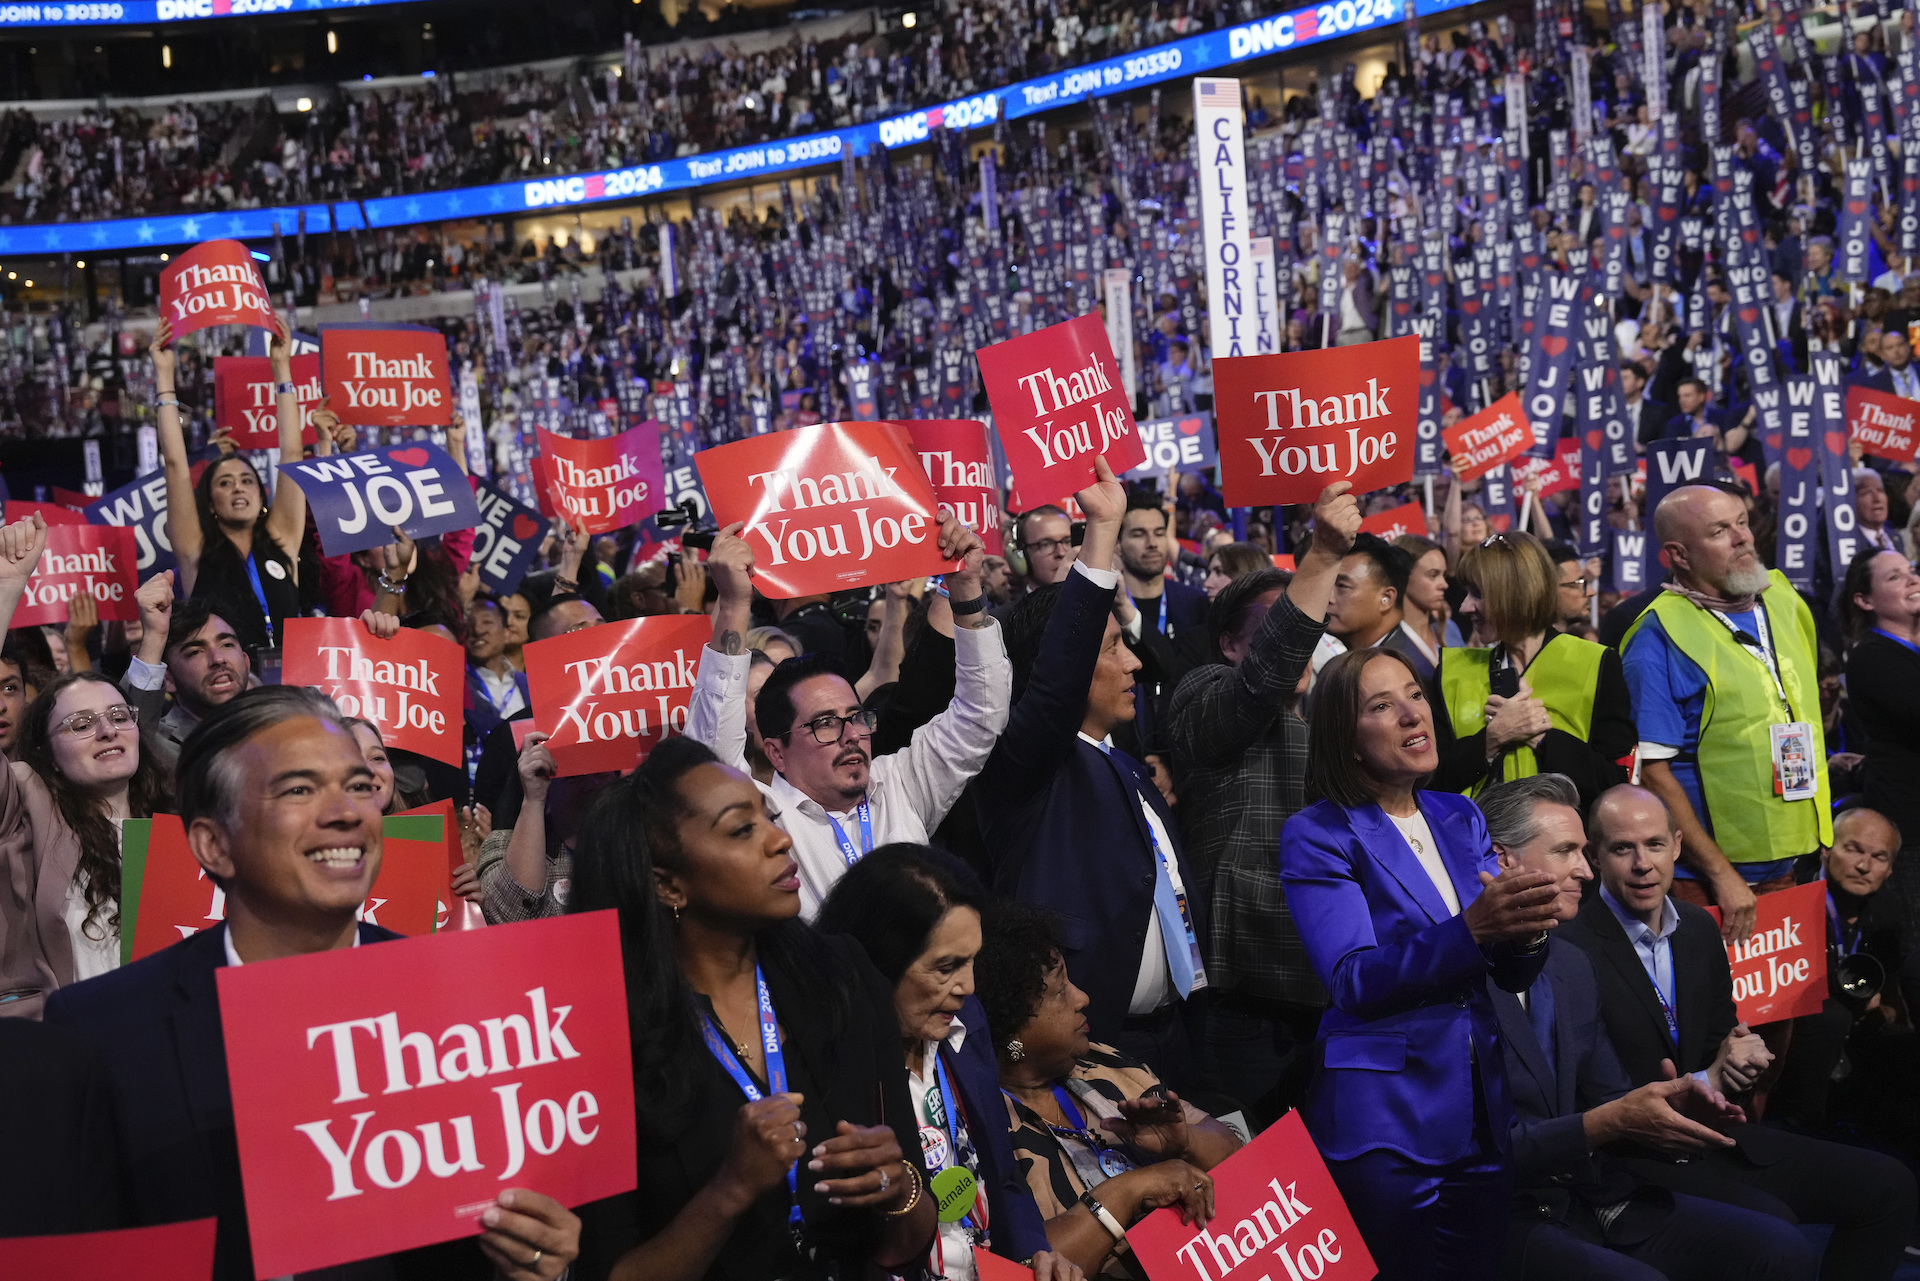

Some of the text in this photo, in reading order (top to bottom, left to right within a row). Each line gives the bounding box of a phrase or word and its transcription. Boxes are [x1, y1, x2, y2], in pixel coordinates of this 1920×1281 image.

[44, 10, 62, 21] to
[65, 4, 123, 20] 30330
[1229, 0, 1393, 59] DNC 2024
[1022, 48, 1182, 106] Text JOIN to 30330
[1750, 31, 1790, 115] WE JOE
[1897, 51, 1916, 82] WE
[1700, 54, 1718, 137] WE JOE
[880, 94, 999, 146] DNC 2024
[1461, 117, 1476, 141] WE
[1660, 112, 1678, 139] WE
[1789, 79, 1815, 170] WE JOE
[1861, 83, 1887, 171] WE JOE
[686, 135, 842, 180] Text JOIN to 30330
[1301, 133, 1316, 158] WE
[1503, 129, 1519, 157] WE
[1593, 139, 1611, 168] WE
[1713, 147, 1732, 177] WE
[525, 165, 664, 207] DNC 2024
[1440, 149, 1457, 228] WE JOE
[1481, 164, 1497, 190] WE
[1551, 129, 1570, 209] WE JOE
[1510, 174, 1524, 215] JOE
[1212, 117, 1244, 357] CALIFORNIA
[1652, 168, 1684, 277] WE JOE
[1846, 161, 1872, 274] WE JOE
[1901, 197, 1919, 249] JOE
[1322, 214, 1344, 307] WE JOE
[1423, 239, 1442, 271] WE
[1495, 242, 1514, 273] WE
[1606, 192, 1629, 291] WE JOE
[174, 261, 262, 294] Thank
[1392, 267, 1411, 299] WE
[1750, 249, 1769, 299] JOE
[170, 284, 271, 321] You Joe
[1254, 262, 1273, 353] ILLIN
[1454, 261, 1490, 372] WE JOE
[1523, 285, 1538, 317] WE
[1728, 267, 1771, 384] WE JOE
[347, 352, 435, 380] Thank
[849, 364, 871, 399] WE
[942, 350, 962, 383] WE
[1529, 275, 1580, 445] WE JOE
[341, 381, 442, 412] You Joe
[674, 382, 691, 417] WE
[1018, 351, 1113, 418] Thank
[1254, 377, 1392, 432] Thank
[1411, 318, 1437, 464] WE JOE
[1582, 364, 1605, 421] WE
[1584, 317, 1628, 465] WE JOE
[241, 408, 277, 433] Yo
[752, 400, 769, 433] WE
[1458, 412, 1515, 450] Thank
[1755, 389, 1782, 430] WE
[1859, 402, 1915, 433] Thank
[1022, 402, 1130, 469] You Joe
[1135, 435, 1204, 472] JOE
[1246, 427, 1397, 478] You Joe
[1462, 428, 1525, 468] You Joe
[1851, 420, 1911, 452] You Joe
[296, 452, 392, 484] WE
[552, 453, 640, 489] Thank
[747, 456, 912, 514] Thank
[918, 450, 996, 491] Thank
[1656, 447, 1706, 484] W
[1784, 381, 1816, 569] WE JOE
[1815, 359, 1857, 566] WE JOE
[337, 467, 456, 536] JOE
[553, 481, 600, 518] You
[604, 481, 649, 519] Joe
[938, 493, 998, 535] ou Joe
[469, 522, 523, 580] OE
[754, 507, 928, 567] You Joe
[1617, 534, 1645, 583] WE
[317, 647, 441, 698] Thank
[564, 648, 697, 698] Thank
[393, 691, 446, 736] Joe
[560, 695, 688, 745] You Jo
[859, 804, 870, 823] DNC
[842, 842, 857, 865] DNC
[1723, 916, 1803, 967] hank
[758, 980, 774, 1013] 2024
[1730, 957, 1810, 1002] ou Joe
[763, 1023, 779, 1054] DNC
[1663, 1010, 1677, 1032] 2024
[306, 986, 582, 1104] Thank
[294, 1081, 600, 1203] You Joe
[1176, 1177, 1313, 1281] Thank
